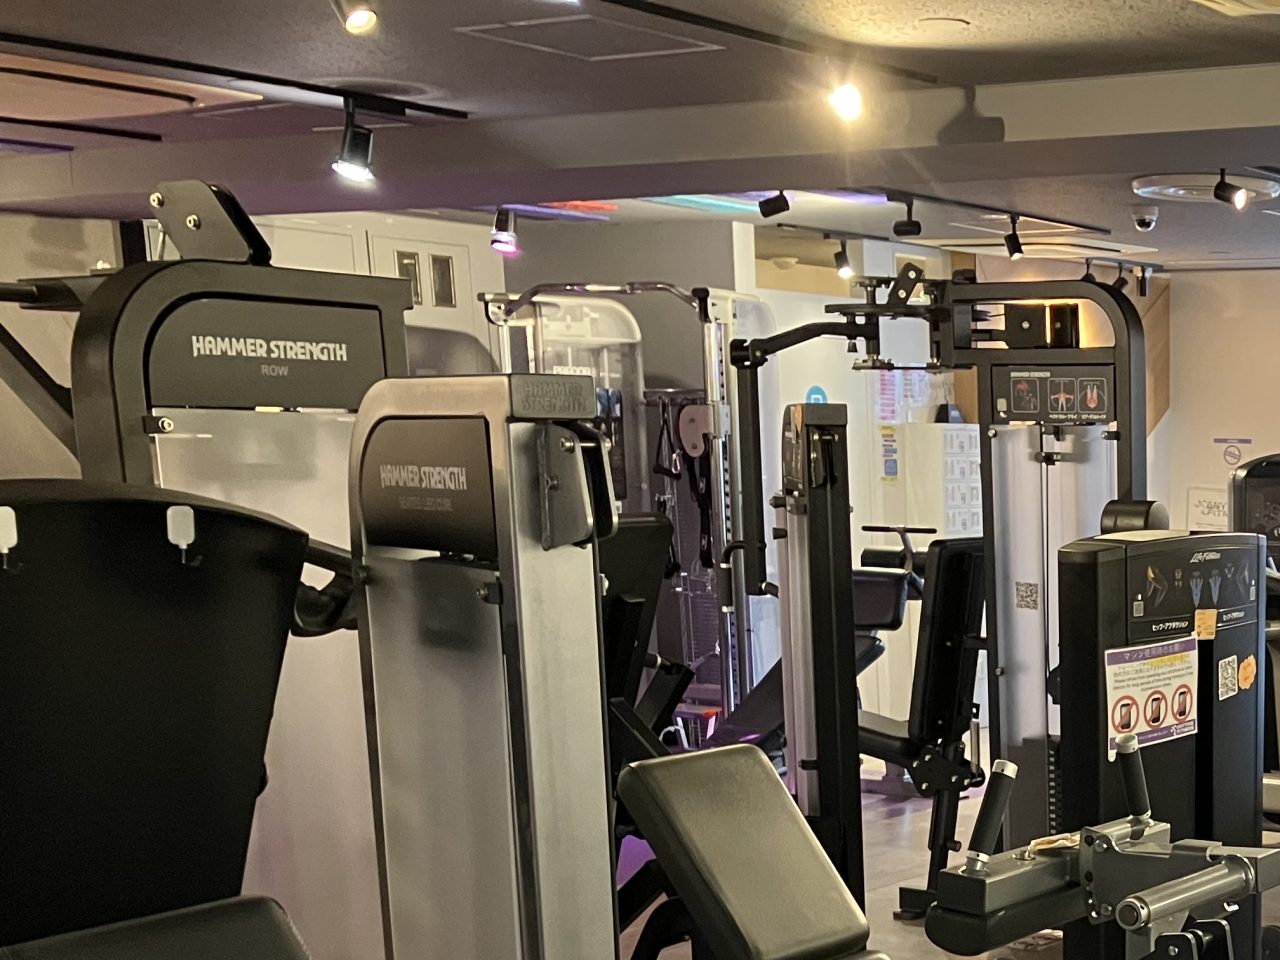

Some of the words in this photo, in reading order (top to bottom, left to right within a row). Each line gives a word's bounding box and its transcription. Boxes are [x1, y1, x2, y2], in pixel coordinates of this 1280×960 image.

[191, 335, 267, 357] HAMMER
[269, 340, 348, 361] STRENGTH
[261, 364, 289, 376] ROW
[380, 464, 420, 488] HAMMER
[421, 466, 467, 490] STRENGTH
